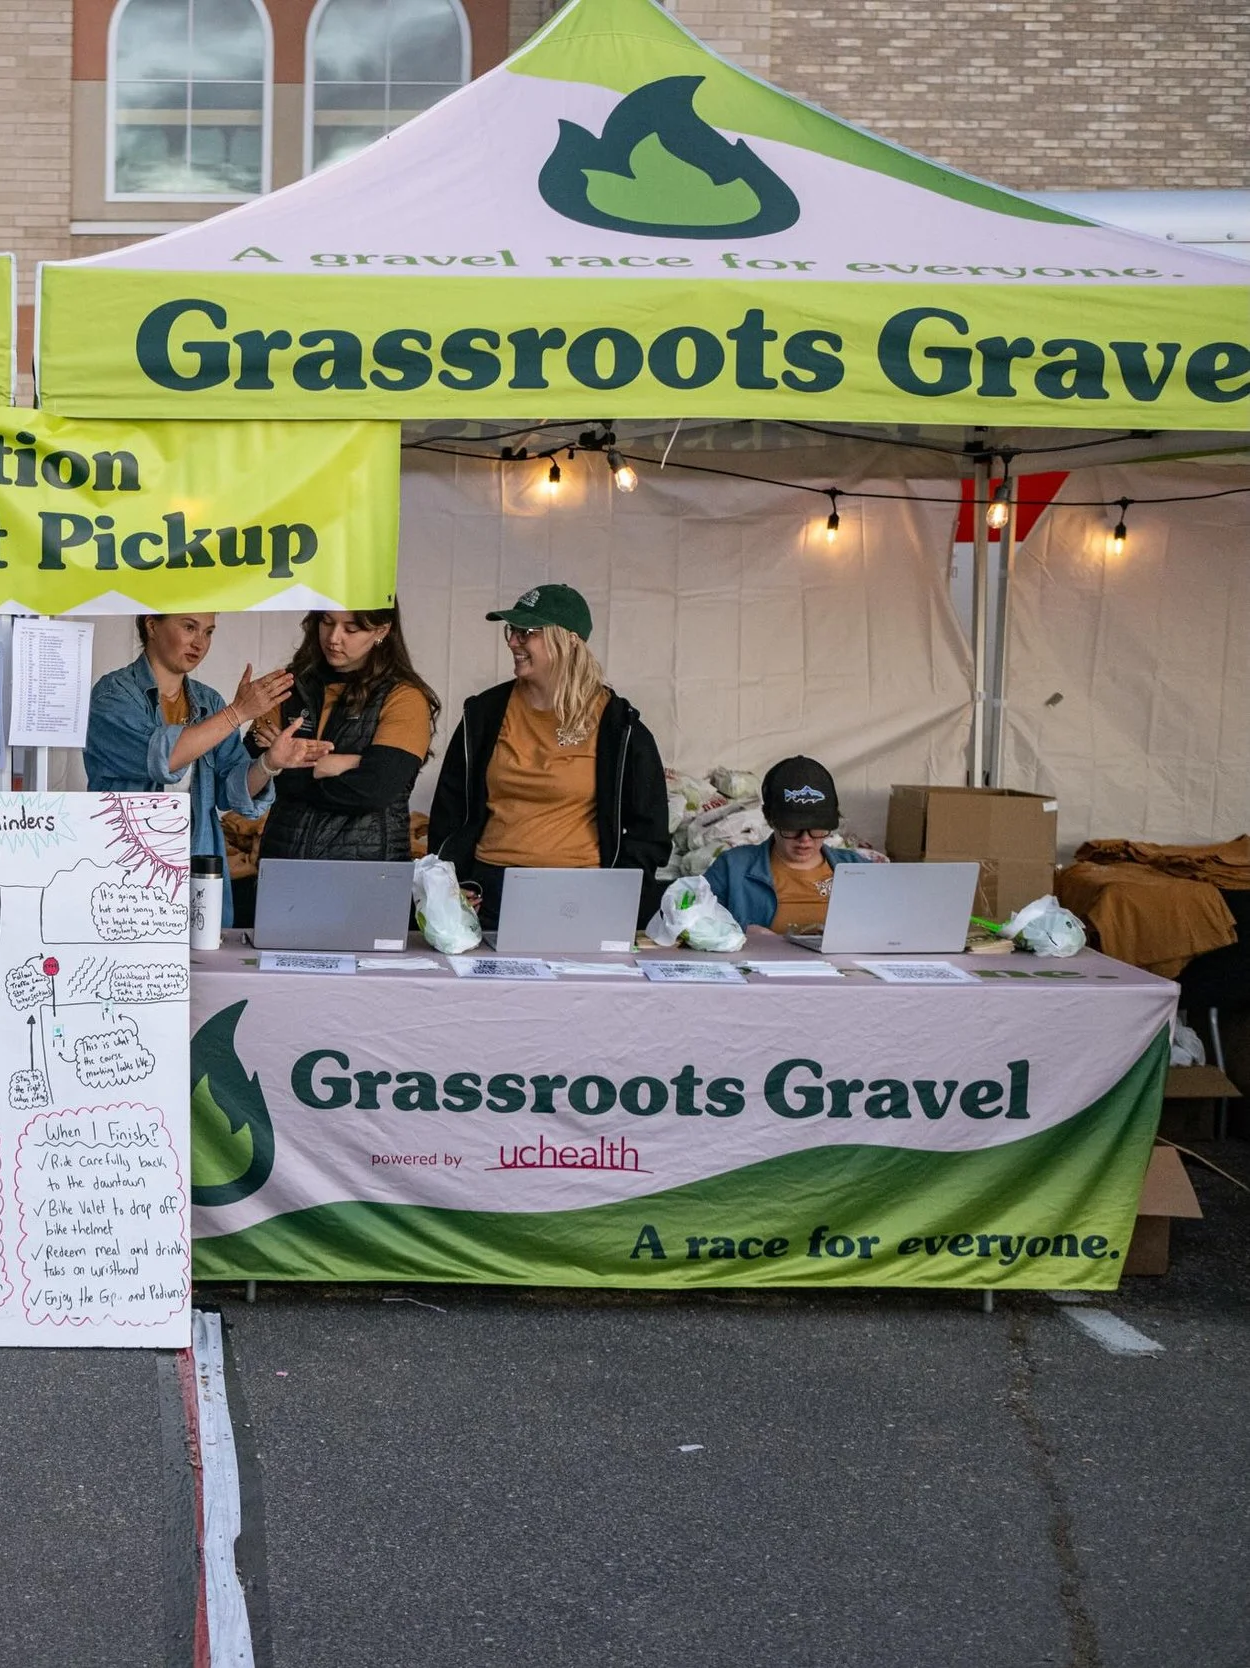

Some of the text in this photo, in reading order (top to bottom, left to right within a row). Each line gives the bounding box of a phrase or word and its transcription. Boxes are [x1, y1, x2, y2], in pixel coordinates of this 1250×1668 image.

[231, 246, 1186, 279] A gravel race for everyone.
[137, 298, 1250, 402] Grassroots Grave
[39, 509, 318, 579] Pickup
[119, 894, 137, 903] going
[141, 891, 149, 900] to
[153, 891, 164, 900] be
[99, 904, 111, 912] hot
[114, 971, 150, 980] Washboard
[147, 983, 161, 992] may
[79, 1037, 129, 1055] This is what
[84, 1057, 94, 1066] the
[86, 1058, 150, 1079] marking looks like
[27, 1082, 41, 1095] right
[290, 1049, 1031, 1121] Grassroots Gravel
[45, 1122, 159, 1142] When I Finish?
[51, 1153, 72, 1169] Ride
[139, 1156, 167, 1168] back
[371, 1135, 640, 1171] powered by uchealth
[47, 1173, 146, 1192] to the downtown
[49, 1195, 178, 1220] Bike Valet to drop off
[45, 1221, 67, 1236] bike
[46, 1238, 186, 1259] Redeem meal and drink
[630, 1225, 1121, 1266] A race for everyone.
[44, 1258, 139, 1277] tabs on wristband
[45, 1290, 73, 1310] Enjoy
[79, 1286, 93, 1306] the
[128, 1287, 145, 1301] and
